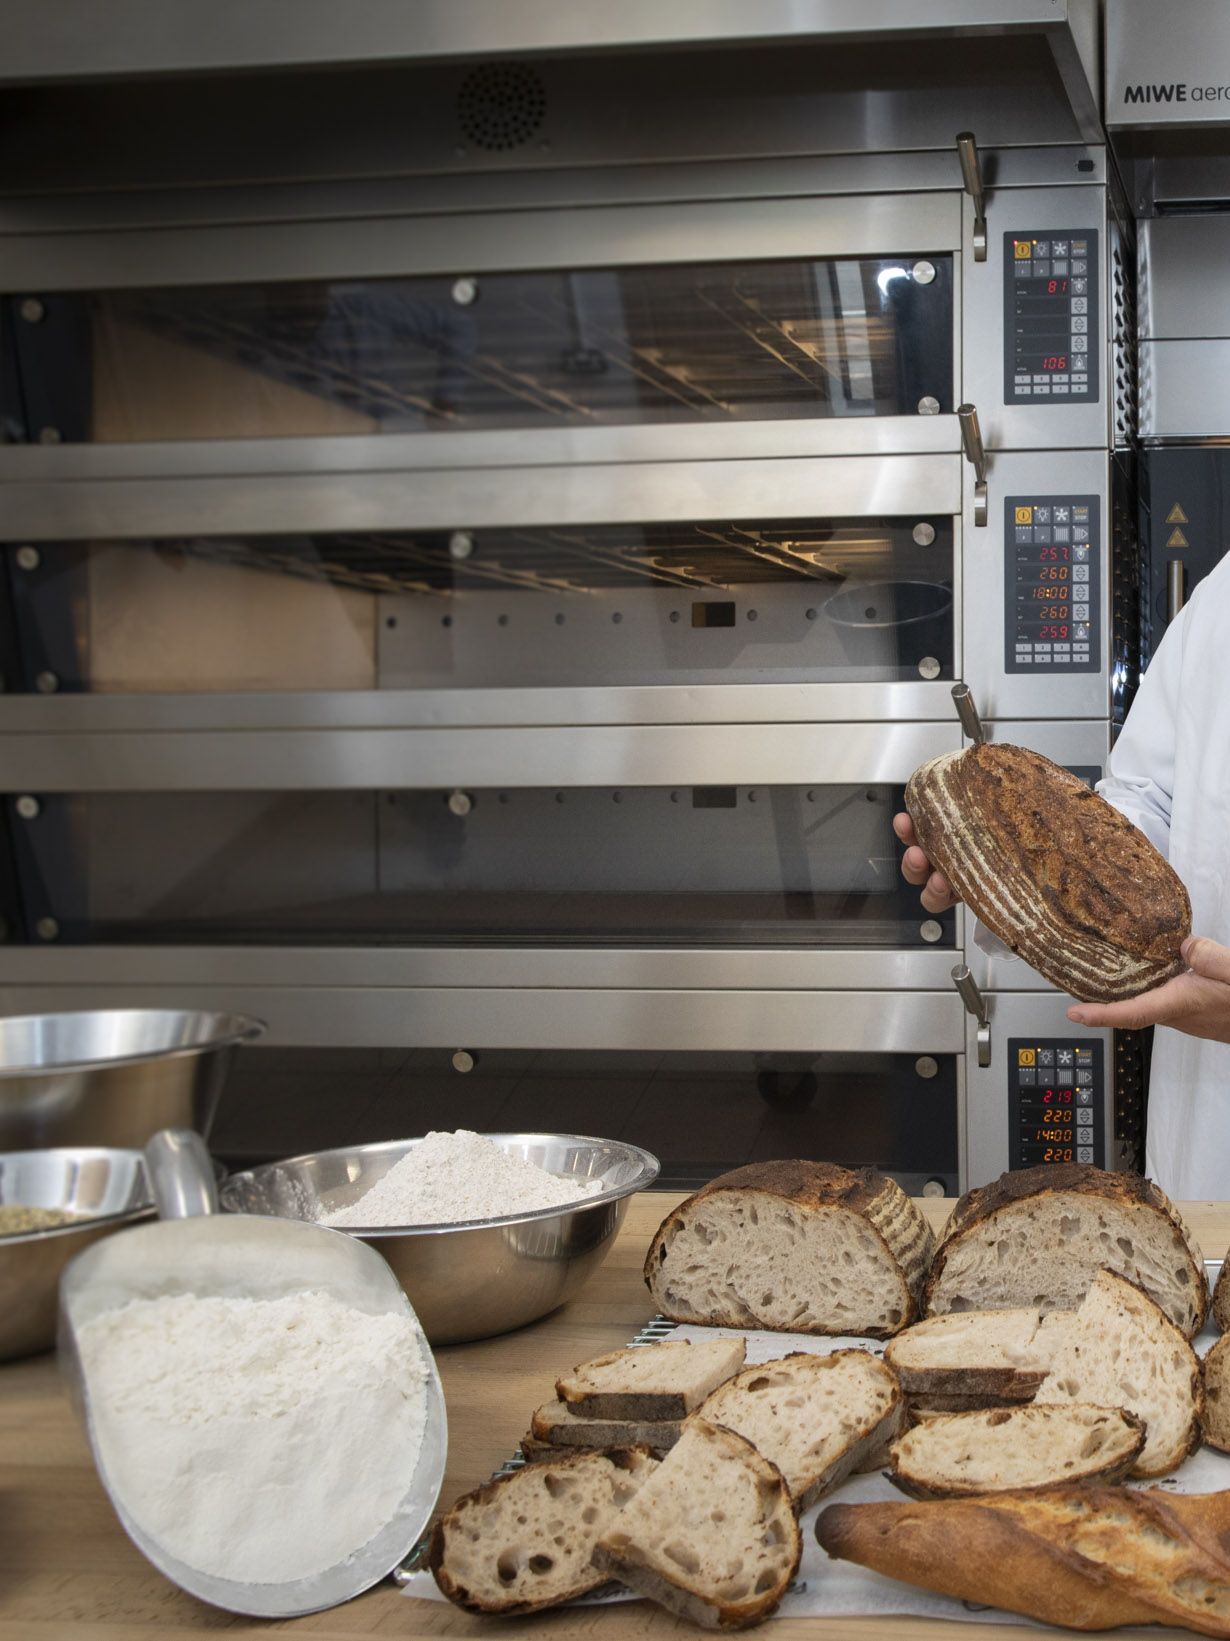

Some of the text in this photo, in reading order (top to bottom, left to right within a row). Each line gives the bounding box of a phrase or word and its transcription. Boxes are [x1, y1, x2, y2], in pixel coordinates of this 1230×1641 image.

[1123, 84, 1187, 104] MIWE
[1043, 356, 1066, 370] 106
[1040, 547, 1068, 560] 257
[1040, 567, 1068, 580] 260
[1032, 586, 1068, 599] 18:00
[1040, 606, 1068, 619] 260
[1040, 625, 1068, 638] 259
[1043, 1090, 1072, 1103] 219
[1044, 1109, 1072, 1122] 220
[1036, 1129, 1072, 1142] 14:00
[1044, 1148, 1072, 1162] 220
